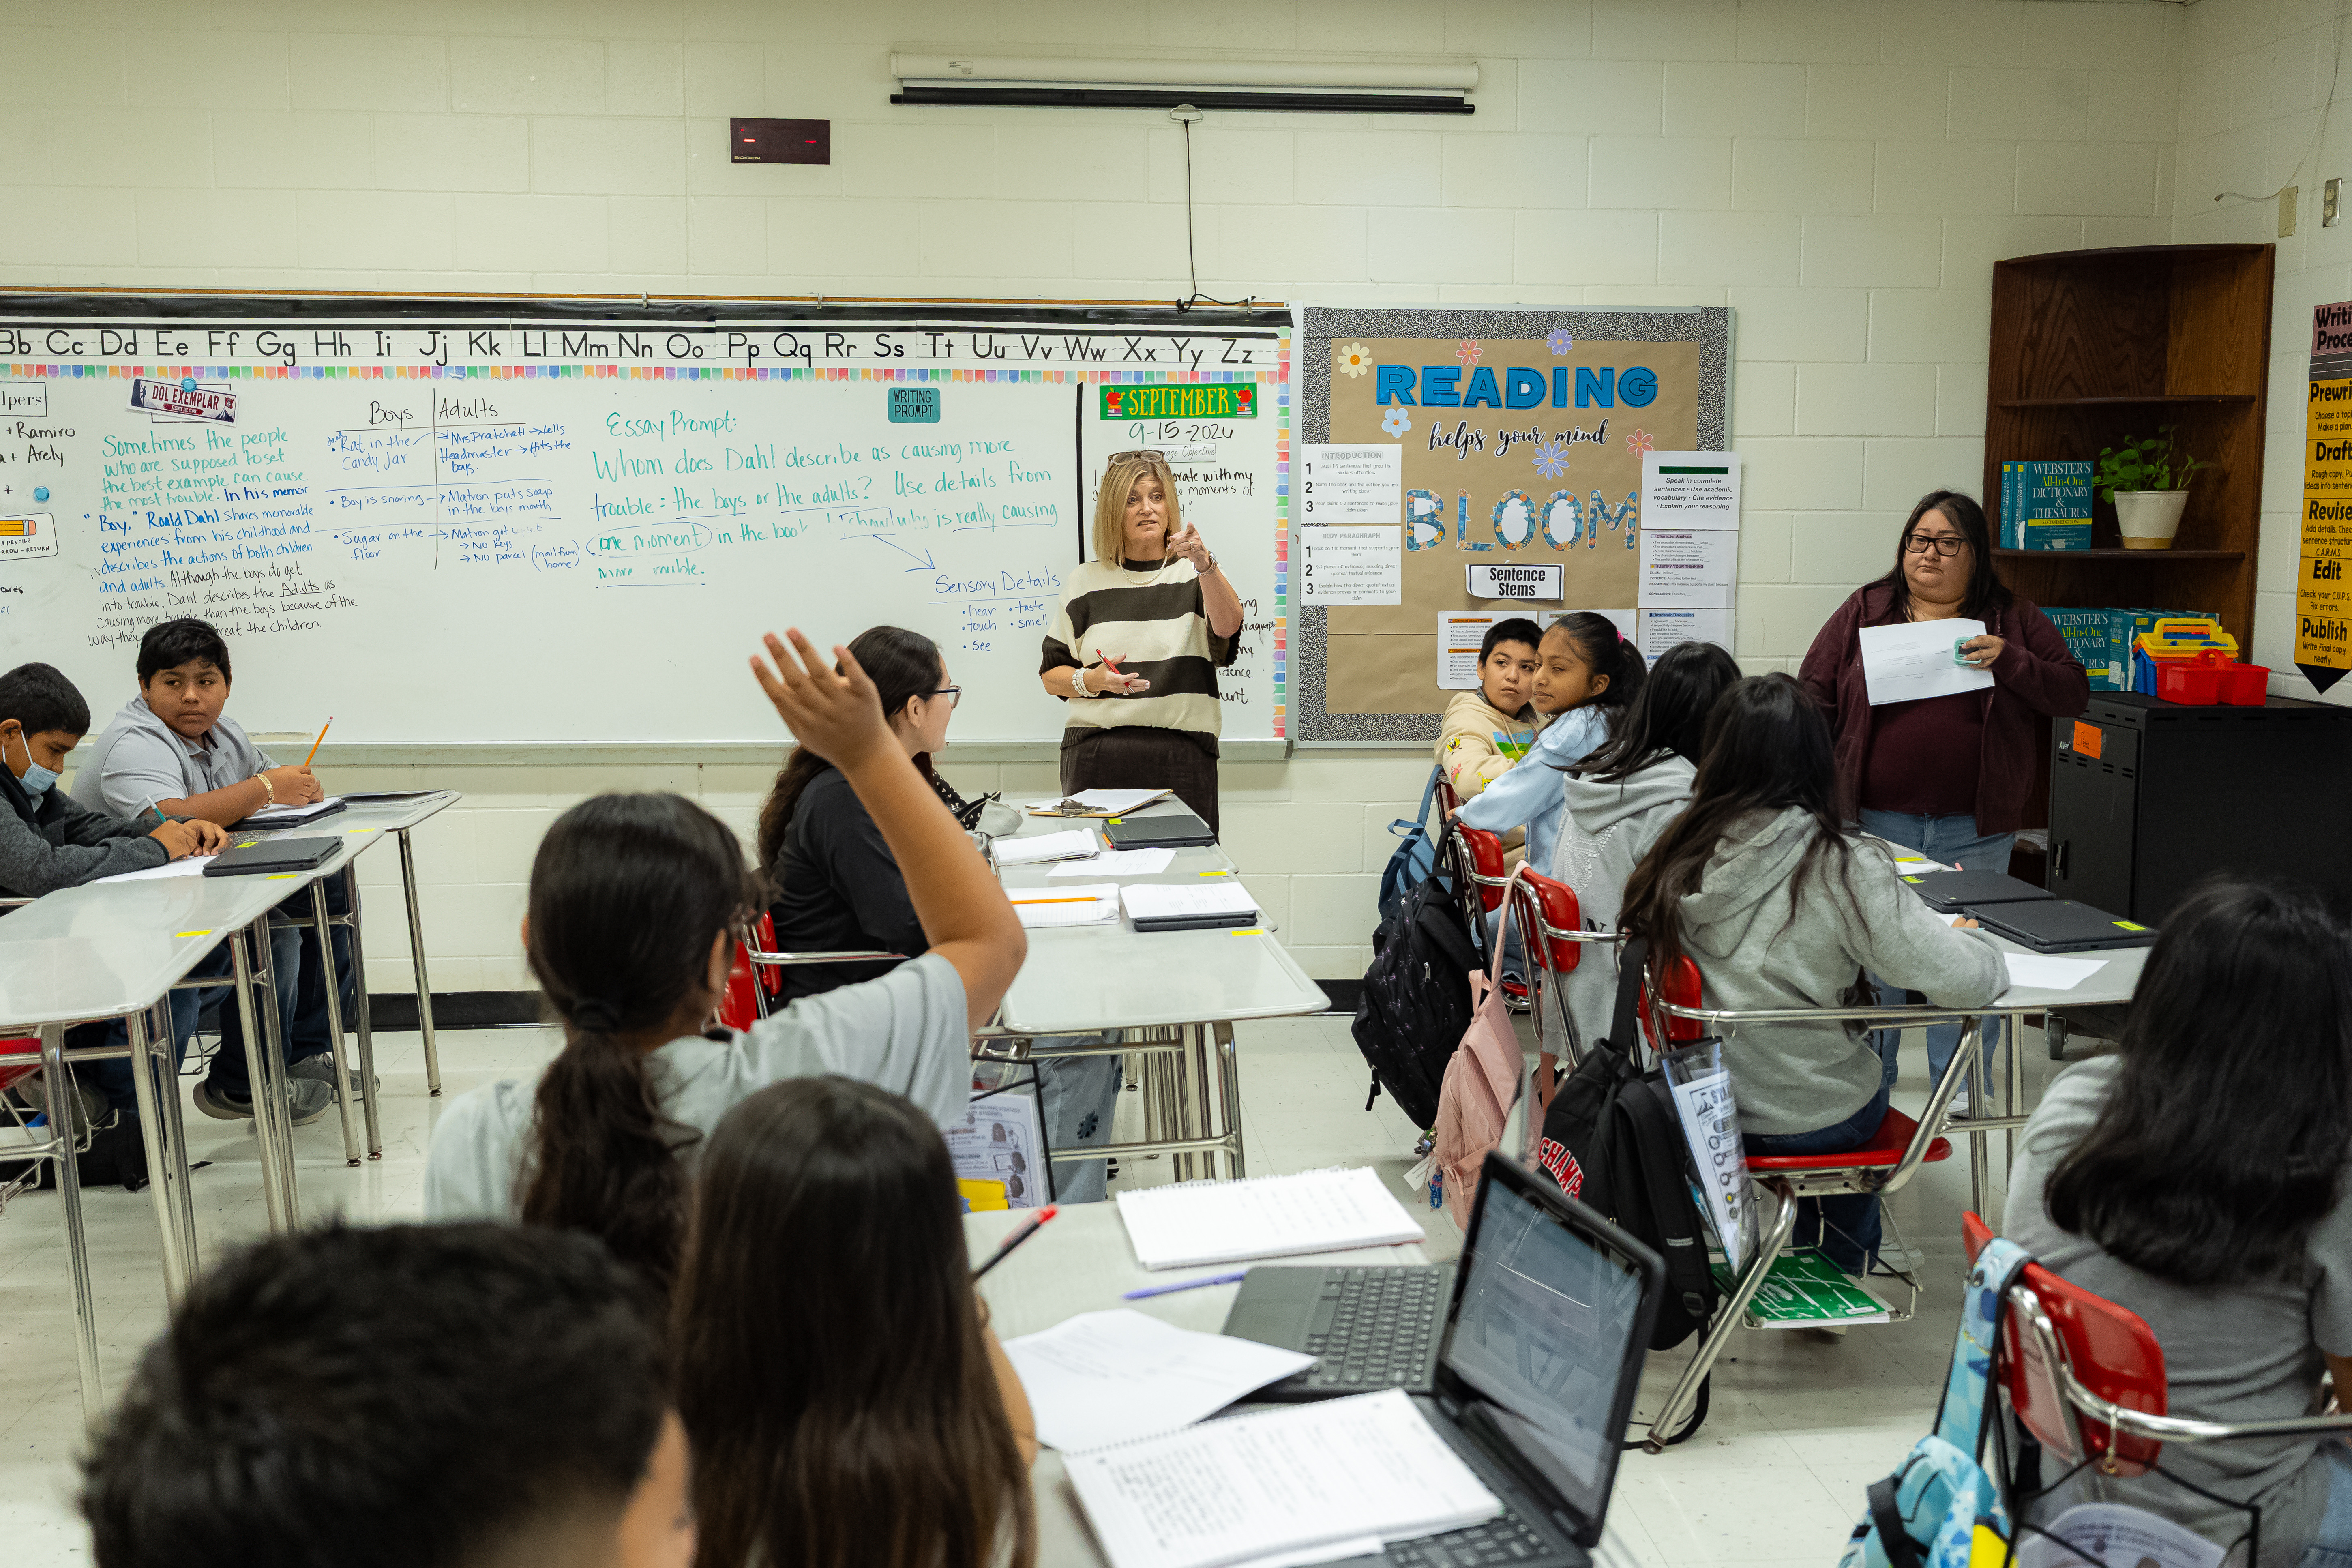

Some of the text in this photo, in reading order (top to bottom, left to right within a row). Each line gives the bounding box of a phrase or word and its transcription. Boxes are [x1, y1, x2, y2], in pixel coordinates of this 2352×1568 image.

[45, 329, 84, 356] Cc
[100, 329, 138, 356] Dd
[156, 329, 188, 356] Ee
[208, 330, 240, 357] Ff
[255, 330, 296, 367] Gg
[314, 330, 352, 357] Hh
[375, 330, 392, 357] Ii
[418, 330, 449, 367] Jj
[467, 330, 502, 357] Kk
[522, 330, 547, 357] Ll
[562, 332, 608, 358] Mm
[615, 332, 653, 358] Nn
[666, 332, 705, 359] Oo
[728, 332, 760, 368] Pp
[774, 332, 812, 368] Qq
[824, 332, 858, 358] Rr
[873, 332, 904, 359] Ss
[925, 332, 954, 359] Tt
[972, 333, 1006, 359] Uu
[1021, 335, 1053, 360] Vv
[1063, 336, 1106, 361] Ww
[1122, 337, 1156, 363] Xx
[1171, 337, 1202, 372] Yy
[1220, 337, 1253, 364] Zz
[1376, 365, 1658, 409] READING
[152, 385, 219, 410] DOL EXEMPLAR
[893, 390, 931, 403] WRITING
[1128, 387, 1231, 417] SEPTEMBER
[369, 401, 413, 430] Boys
[439, 398, 498, 420] Adults
[894, 405, 933, 418] PROMPT
[16, 421, 76, 439] Ramiro
[606, 410, 737, 442] Essay Prompt:
[102, 427, 289, 458] Sometimes the people
[341, 436, 410, 453] Rat in the
[1428, 418, 1611, 460] helps your mind
[28, 445, 64, 468] Arely
[440, 447, 512, 463] Headmaster
[1182, 445, 1215, 460] Objective
[1321, 451, 1383, 459] INTRODUCTION
[2316, 440, 2352, 461] Draft
[104, 453, 238, 477] who are supposed
[342, 453, 407, 472] Candy Jar
[592, 440, 1015, 482] Whom does Dahl describe as causing more
[1306, 462, 1311, 475] 1
[2033, 463, 2090, 474] WEBSTER'S
[102, 470, 309, 494] the best example can cause
[1203, 468, 1253, 485] with my
[2041, 476, 2085, 486] All-In-One
[448, 487, 553, 504] Matron puts soap
[673, 486, 704, 511] the
[713, 488, 746, 516] boys
[756, 491, 771, 505] or
[775, 482, 804, 507] the
[812, 475, 873, 504] adults?
[895, 471, 927, 497] Use
[935, 467, 996, 493] details
[1009, 460, 1051, 485] from
[1189, 483, 1236, 497] moments
[2033, 487, 2089, 498] DICTIONARY
[101, 486, 309, 513] the most trouble. In his memoir
[341, 494, 424, 511] Boy is snoring
[2056, 498, 2065, 507] &
[2033, 508, 2088, 518] THESAURUS
[2309, 500, 2352, 521] Revise
[1406, 488, 1638, 554] BLOOM
[7, 538, 30, 546] PENCIL?
[342, 528, 423, 550] Sugar on the
[351, 548, 382, 560] floor
[1489, 566, 1546, 582] Sentence
[2313, 560, 2342, 580] Edit
[935, 566, 1061, 596] Sensory Details
[1498, 582, 1536, 596] Stems
[2300, 589, 2316, 598] Check
[2332, 591, 2351, 601] C.U.P.S.
[969, 600, 1044, 617] hear taste
[967, 619, 997, 631] touch
[2302, 618, 2347, 641] Publish
[973, 640, 992, 651] see
[2303, 641, 2317, 650] Write
[2333, 646, 2346, 656] copy
[2314, 656, 2332, 665] neatly.
